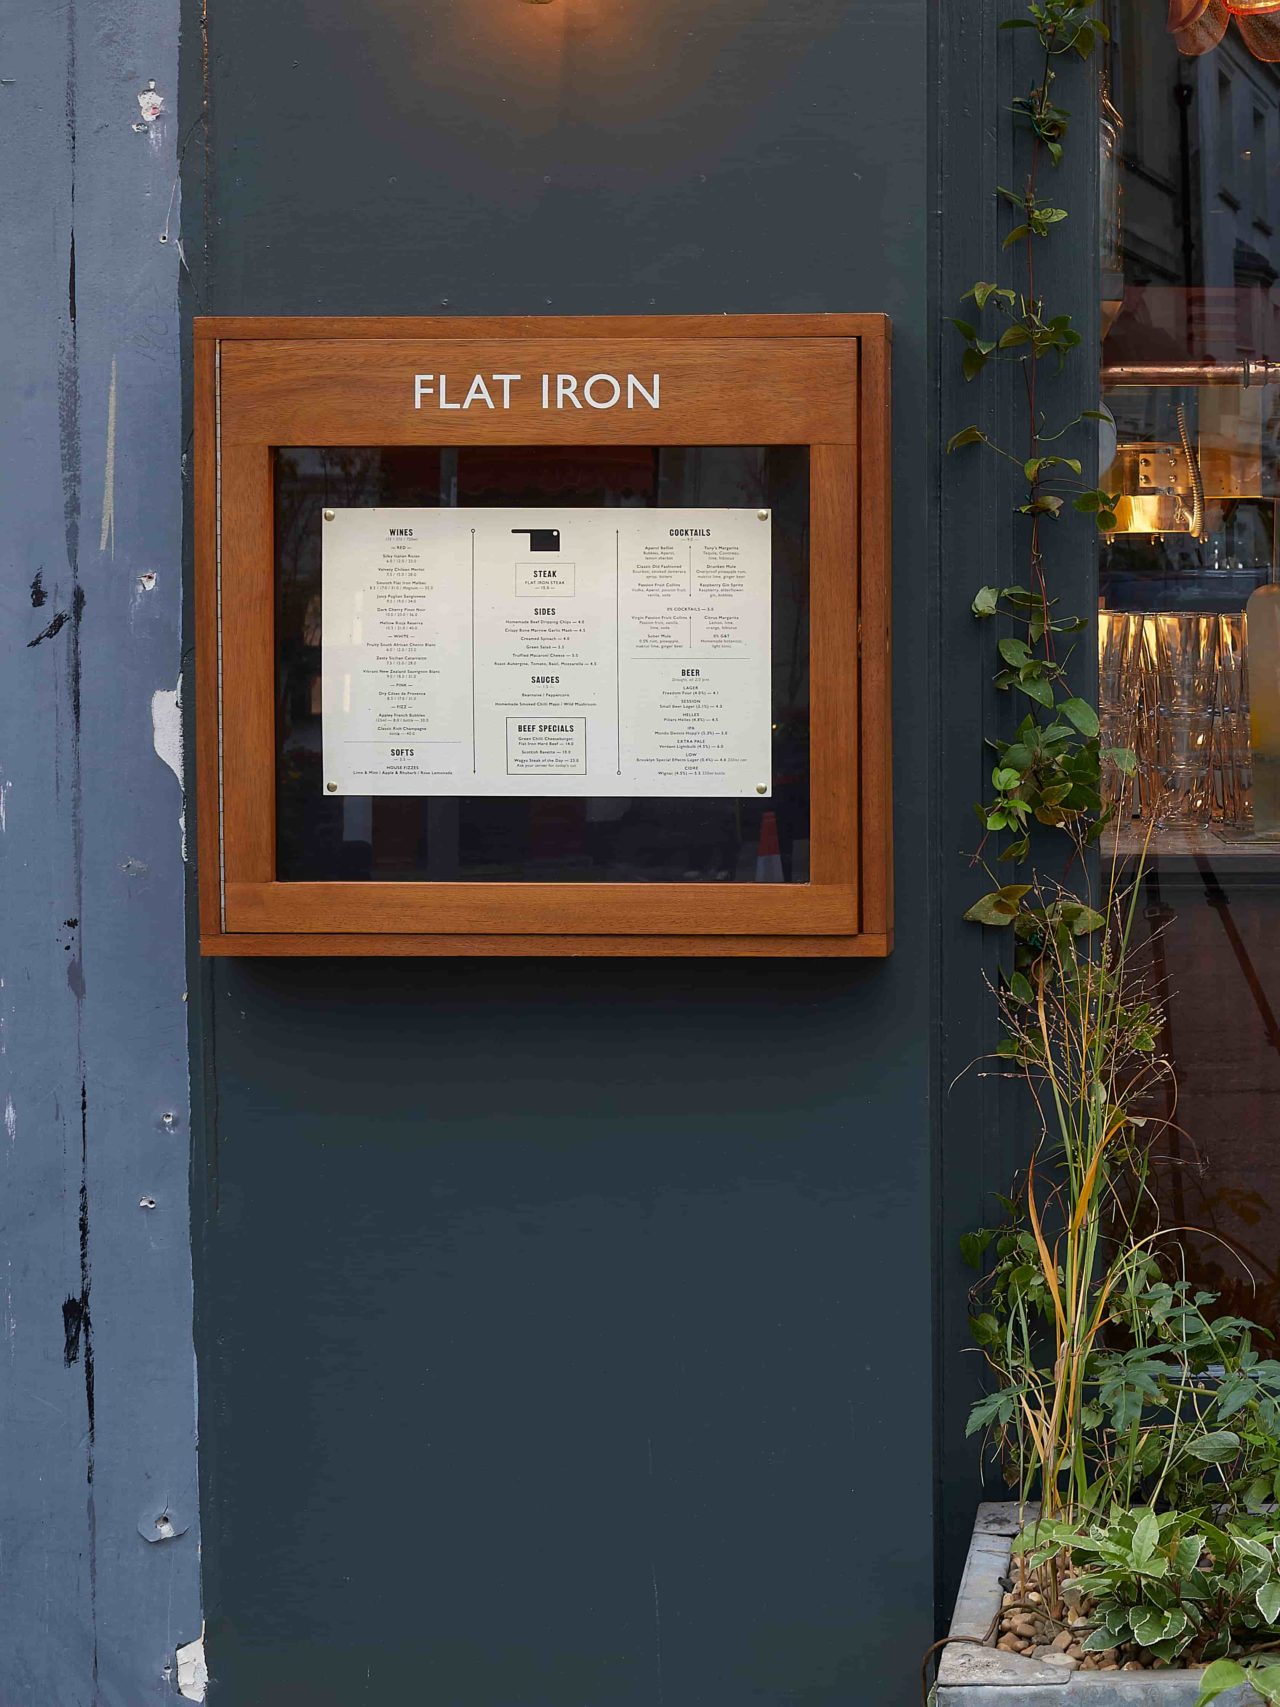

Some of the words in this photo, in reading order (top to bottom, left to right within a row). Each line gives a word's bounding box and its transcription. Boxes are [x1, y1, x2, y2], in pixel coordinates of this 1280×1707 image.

[415, 375, 520, 408] FLAT
[543, 374, 659, 408] IRON
[669, 529, 711, 537] COCKTAILS
[533, 570, 557, 578] STEAK
[534, 608, 556, 616] SIDES
[681, 669, 700, 677] BEER
[531, 676, 560, 684] SAUCES
